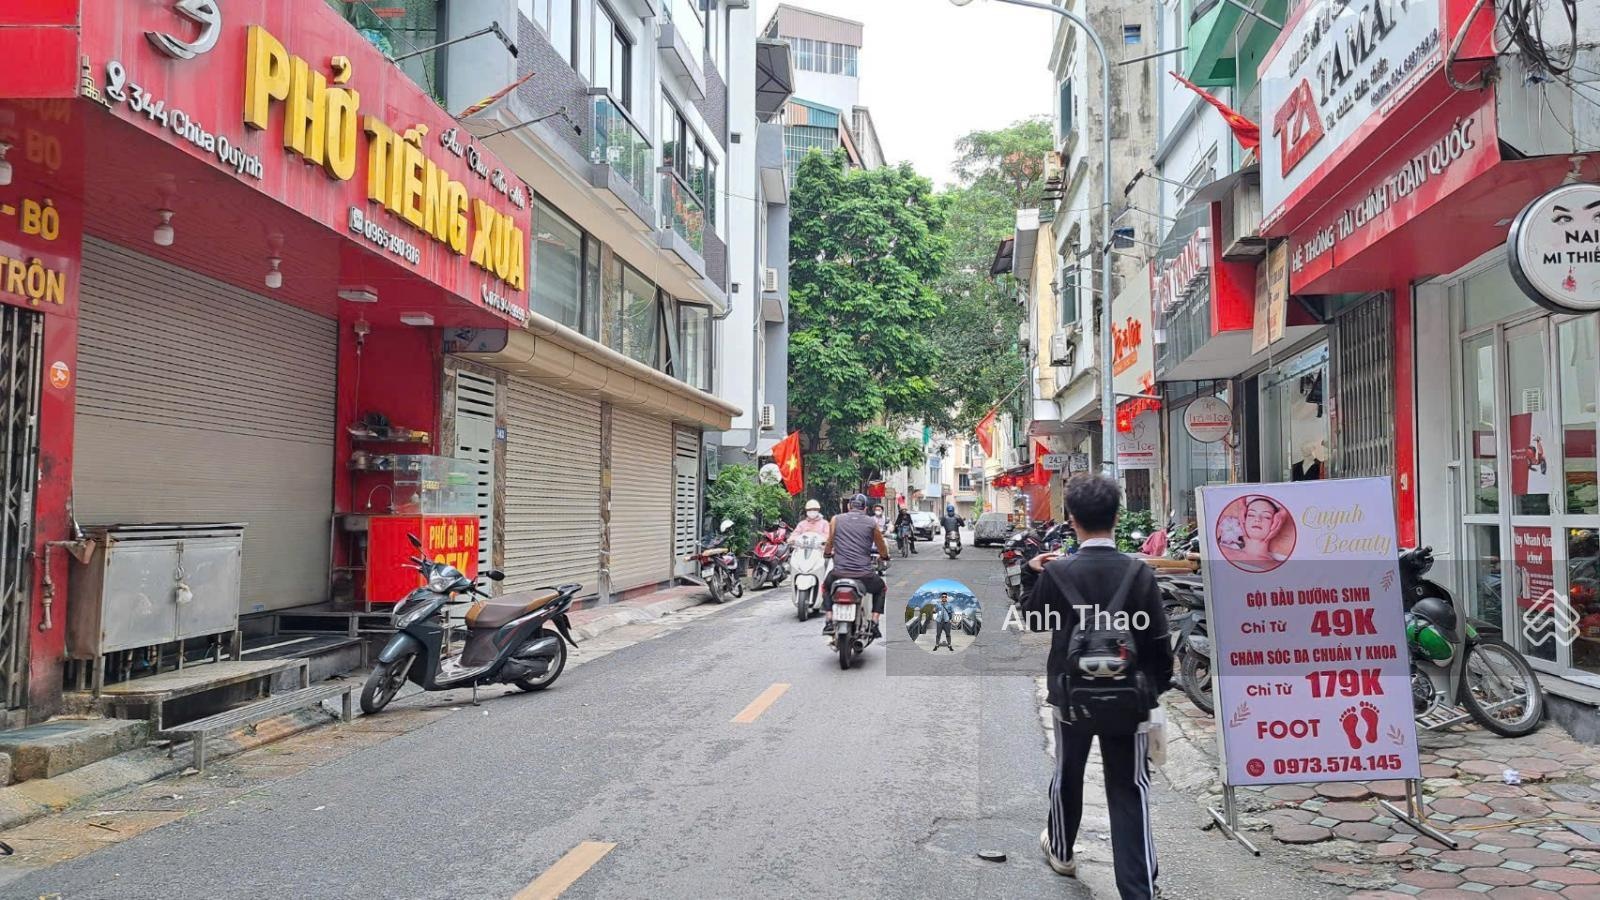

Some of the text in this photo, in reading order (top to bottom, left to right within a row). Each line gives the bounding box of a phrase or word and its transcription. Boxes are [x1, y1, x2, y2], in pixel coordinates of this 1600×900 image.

[244, 24, 359, 181] PHỞ
[128, 82, 263, 180] 344 Chùa Quỳnh
[363, 112, 525, 291] TIẾNG XƯA
[1292, 244, 1303, 273] HỆ
[1304, 224, 1336, 263] THỐNG
[1337, 209, 1354, 242] TÀI
[1355, 185, 1392, 230] CHÍNH
[1390, 155, 1428, 201] TOÀN
[1428, 116, 1476, 176] QUỐC
[22, 198, 60, 241] BÒ
[1543, 252, 1562, 265] MI
[429, 518, 446, 550] PHỞ
[447, 519, 458, 549] GÀ
[464, 520, 475, 547] BÒ
[1317, 532, 1391, 556] Beauty
[1523, 532, 1541, 547] Nhanh
[1246, 586, 1370, 610] GỘI ĐẦU DƯỠNG SINH
[1269, 620, 1287, 633] Từ
[1310, 608, 1378, 638] 49K
[1266, 648, 1291, 665] SÓC
[1312, 642, 1352, 663] CHUẨN
[1354, 646, 1362, 660] Y
[1365, 644, 1397, 661] KHOA
[1274, 681, 1293, 696] Từ
[1304, 667, 1385, 699] 179K
[1256, 718, 1321, 740] FOOT
[1273, 754, 1402, 775] 0973.574.145
